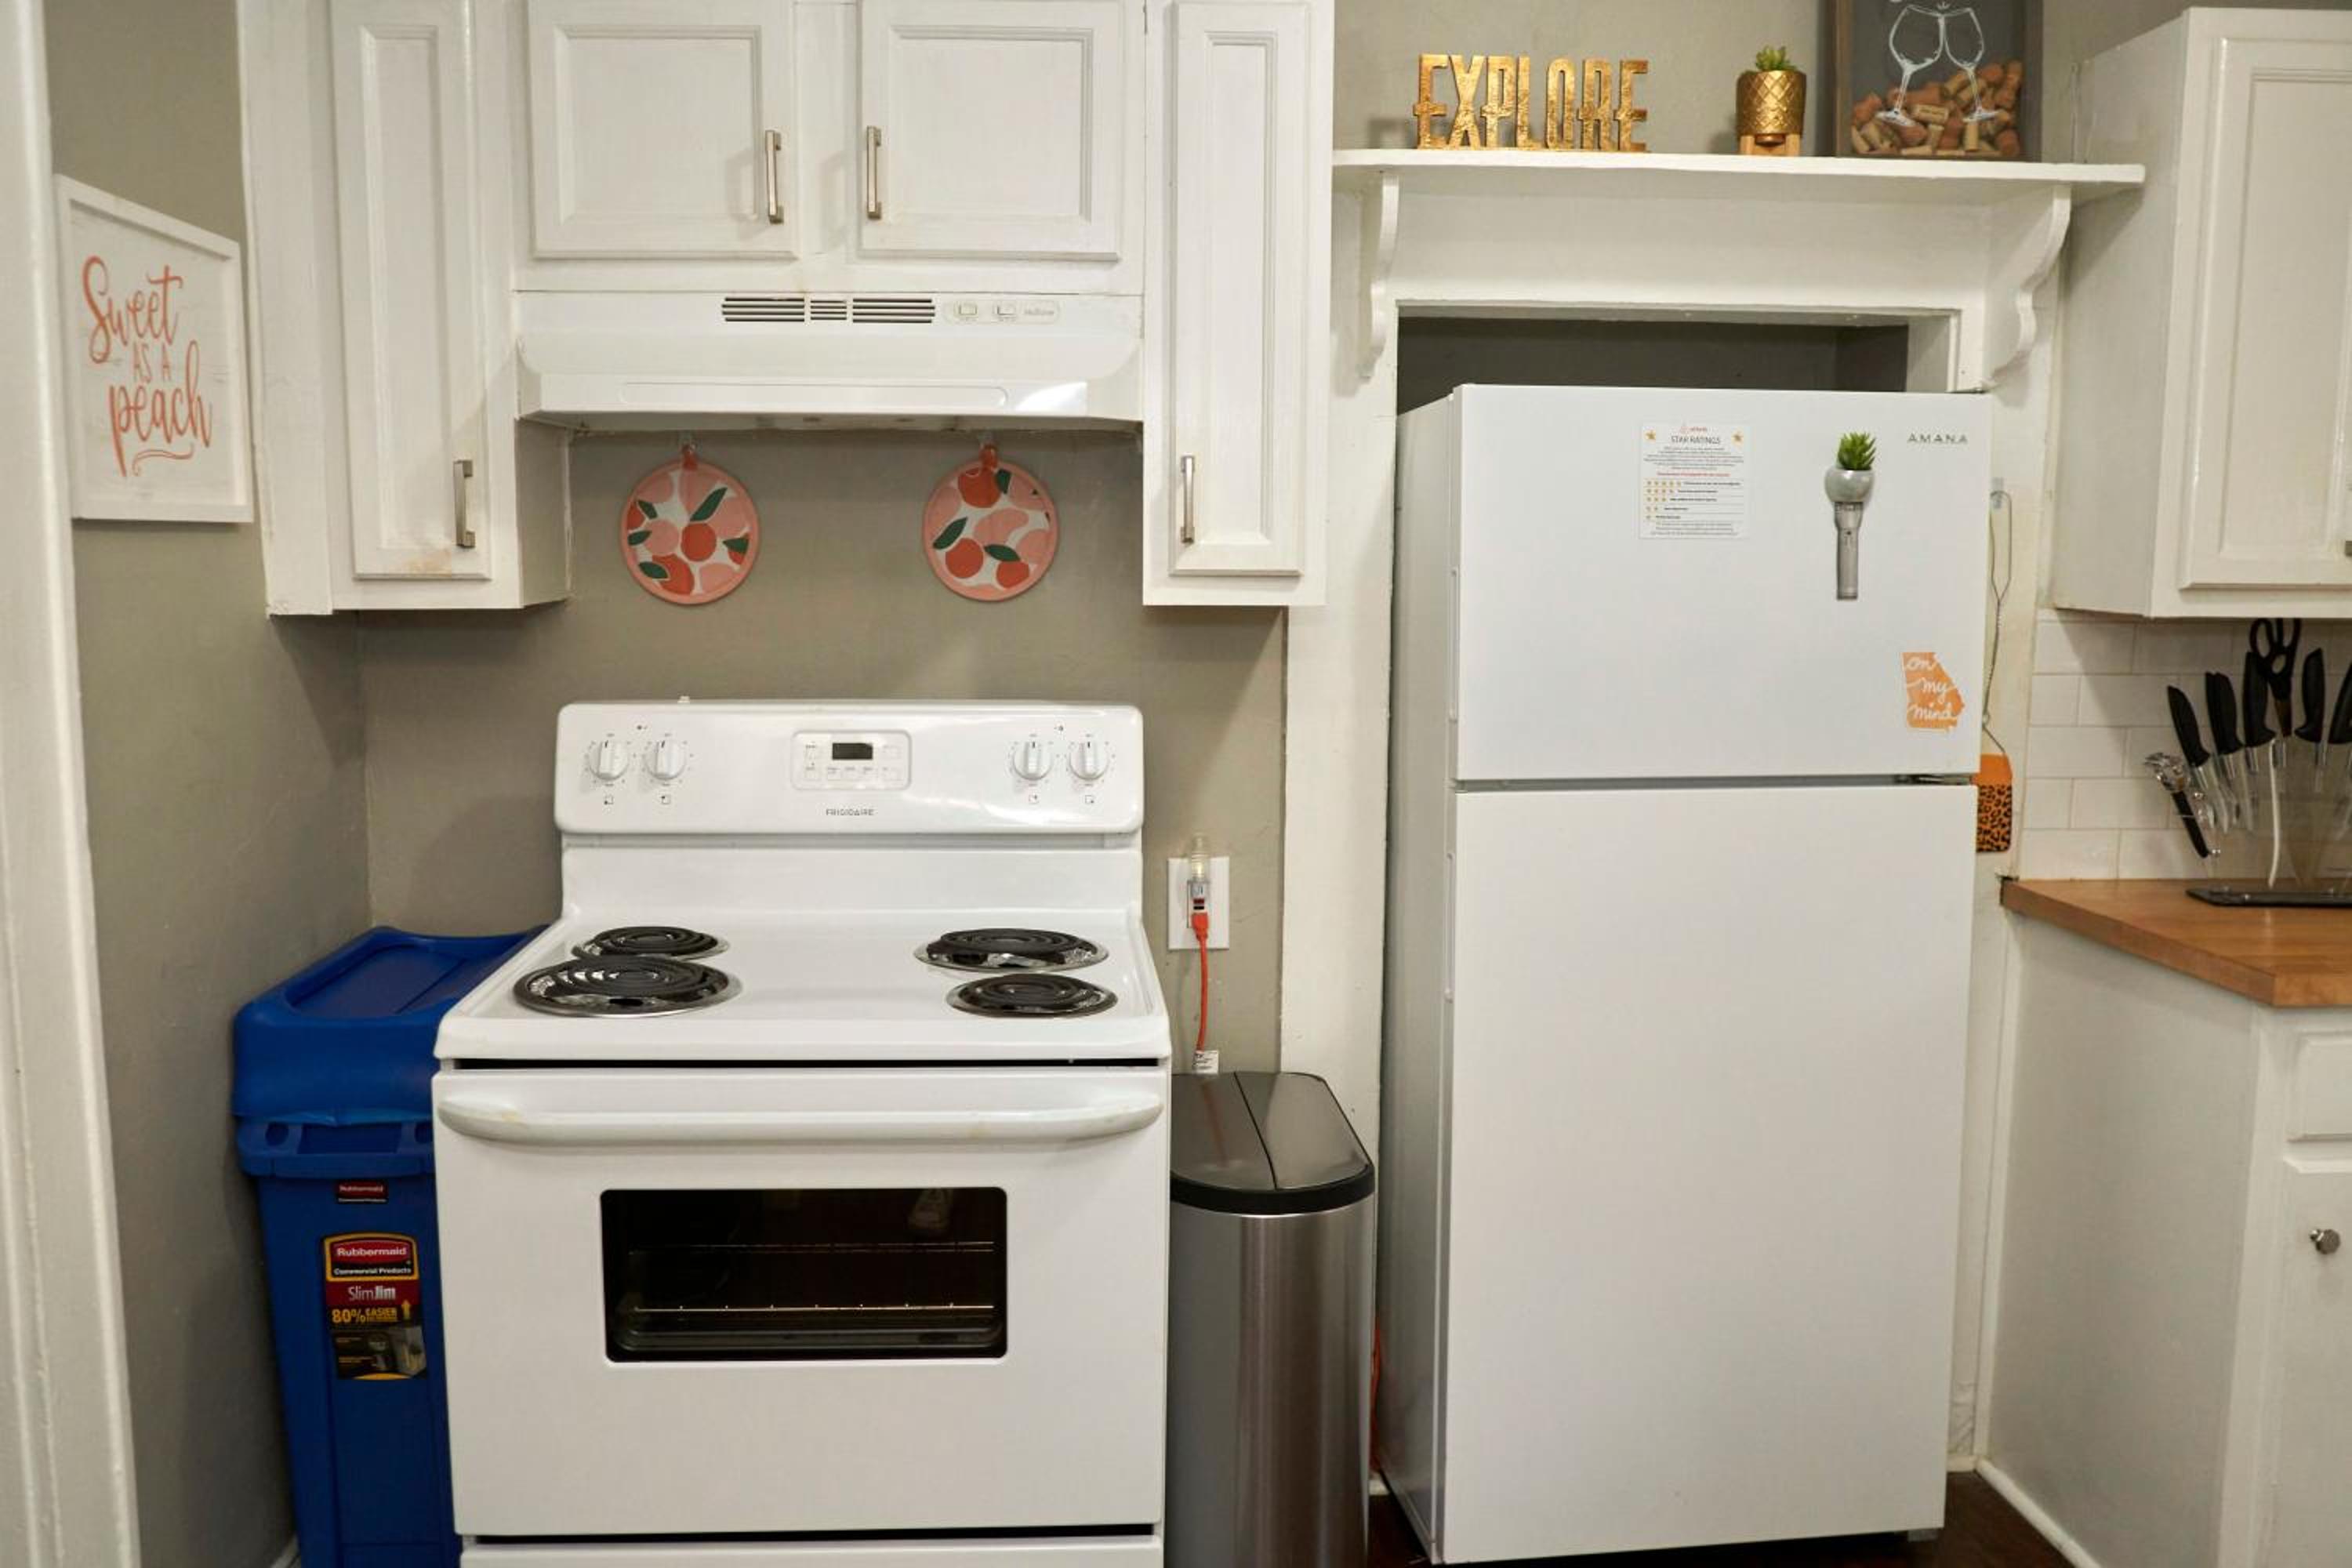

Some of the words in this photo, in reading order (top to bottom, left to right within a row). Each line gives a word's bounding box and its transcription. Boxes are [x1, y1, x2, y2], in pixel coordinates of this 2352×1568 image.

[1413, 54, 1650, 151] EXPLORE
[82, 256, 185, 364] Sweet
[132, 342, 153, 384] AS
[162, 343, 172, 383] A
[109, 339, 214, 477] peach
[1907, 433, 1969, 445] AMANA
[336, 1247, 408, 1257] Rubbermaid
[332, 1308, 366, 1323] 80%
